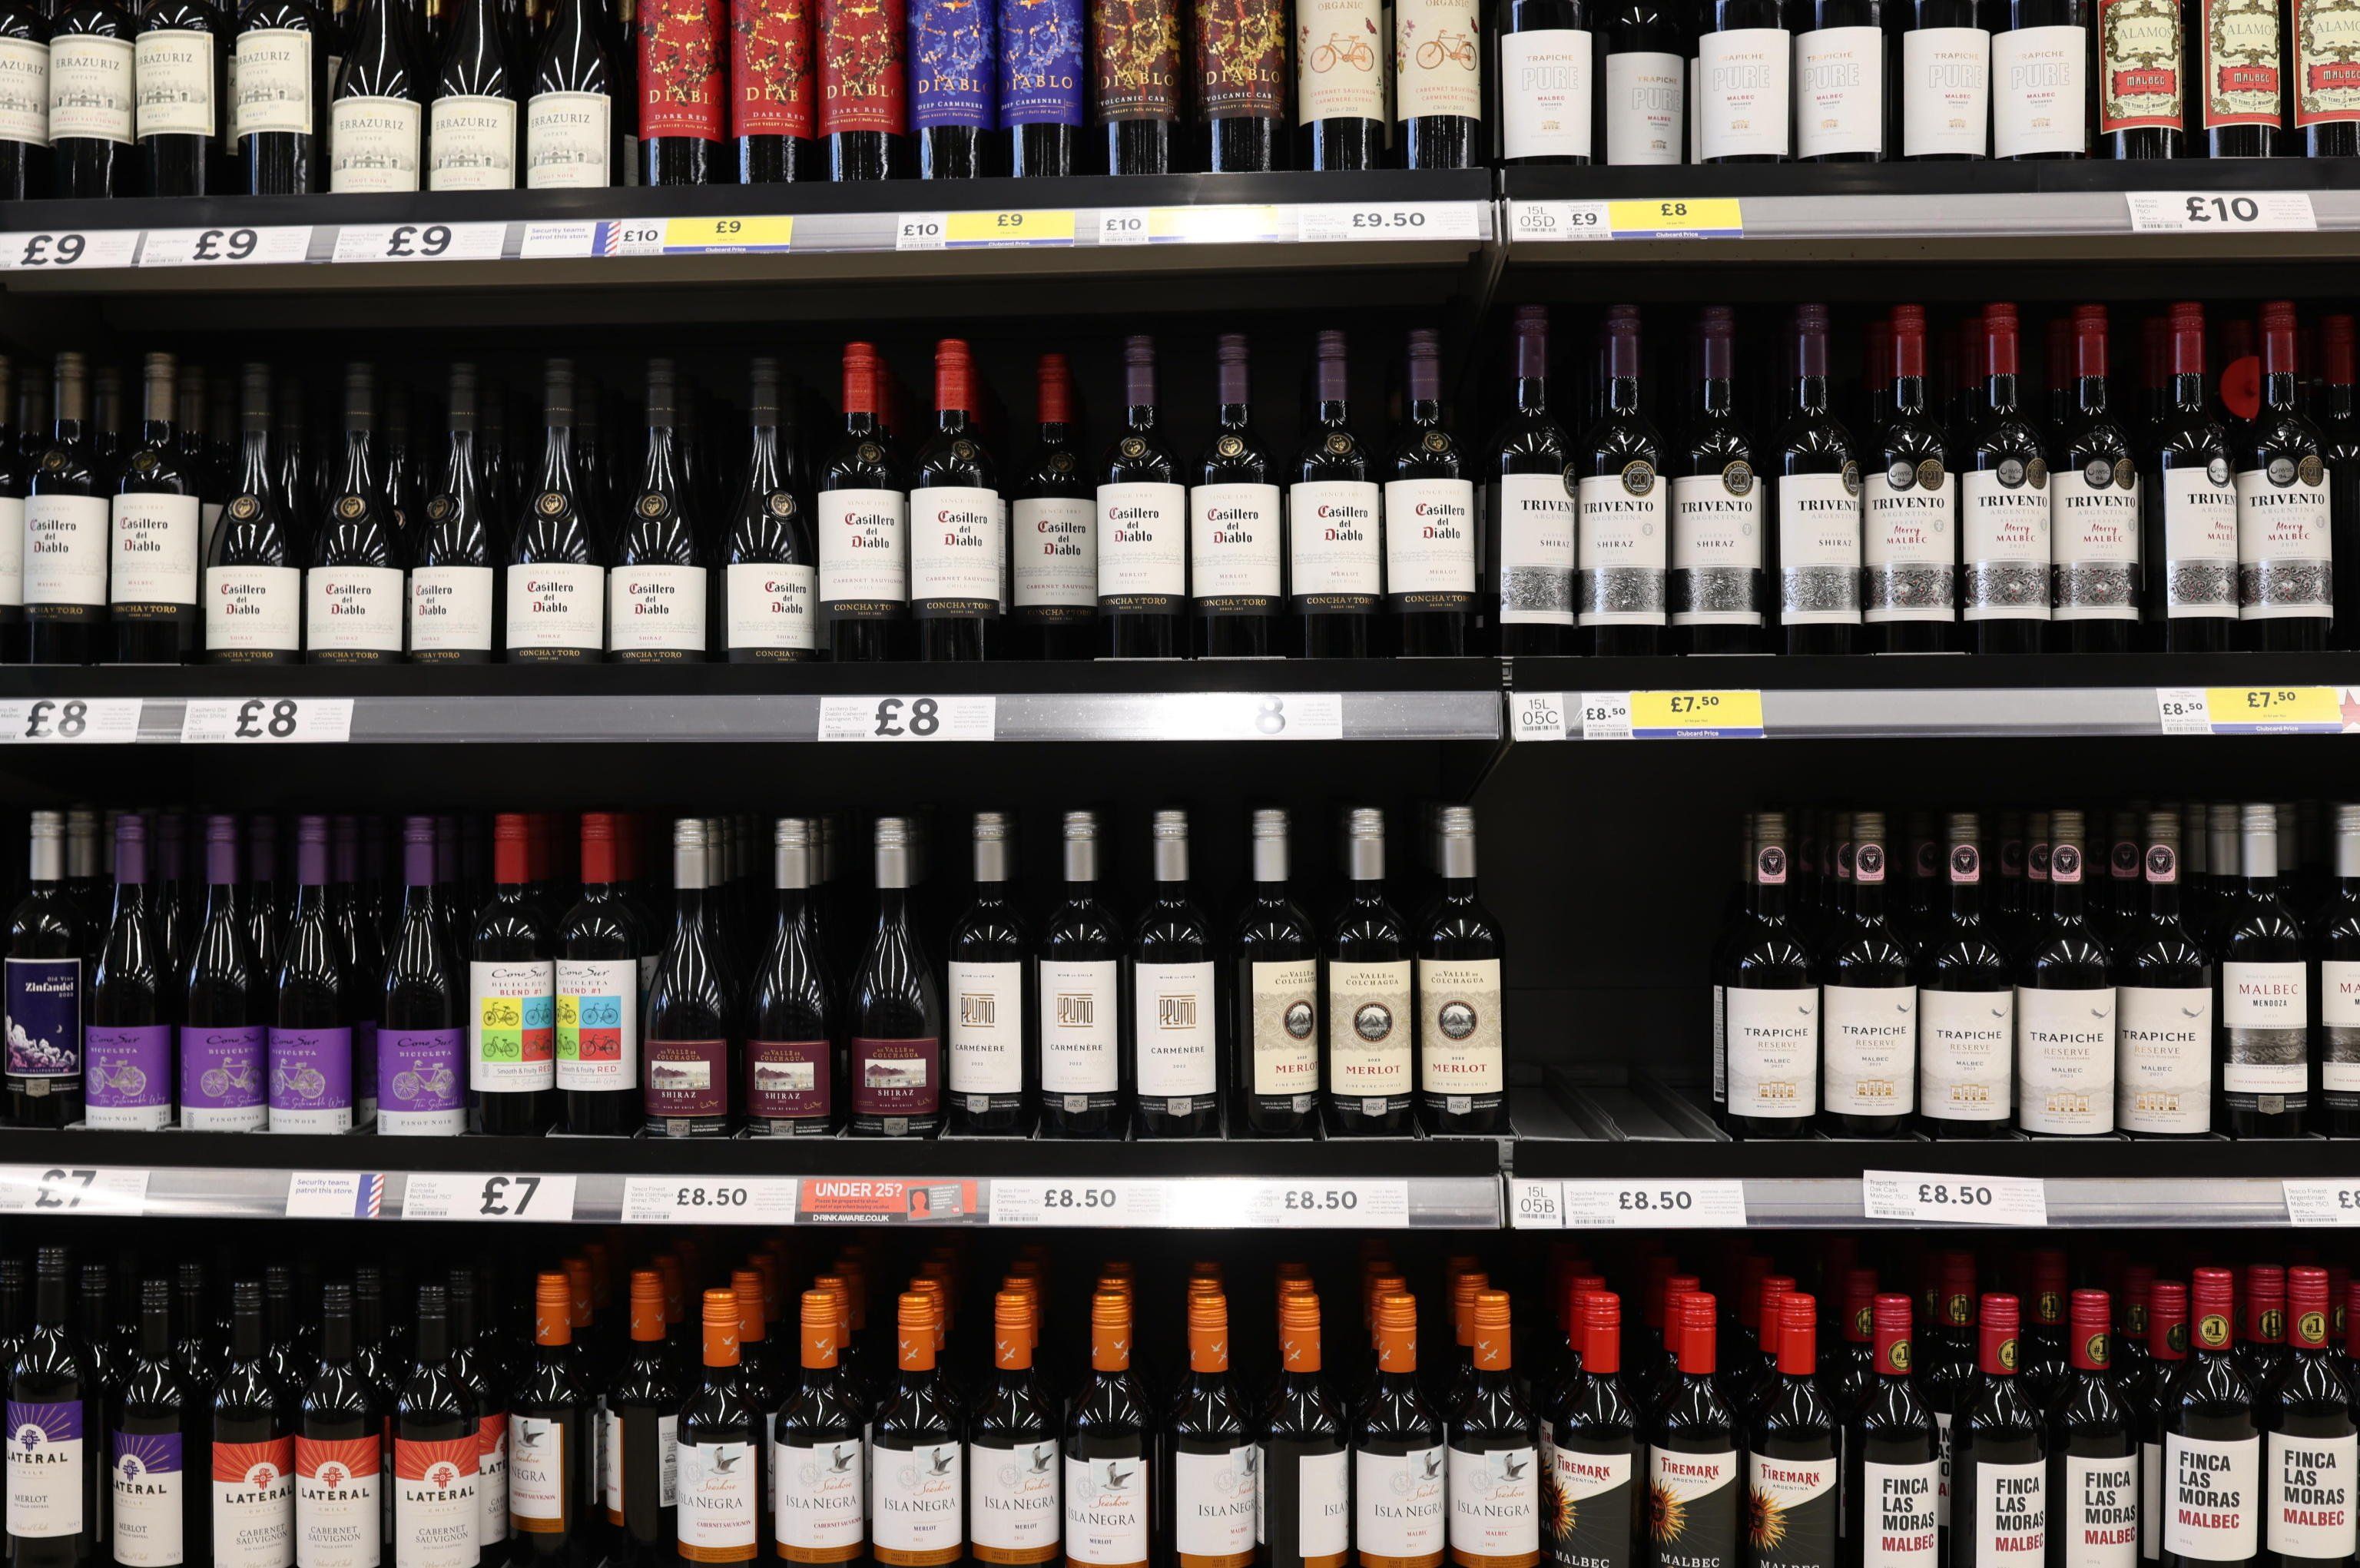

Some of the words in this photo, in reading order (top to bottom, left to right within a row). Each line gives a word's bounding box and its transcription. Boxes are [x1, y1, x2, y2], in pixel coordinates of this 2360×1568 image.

[2120, 26, 2172, 39] ALAMOS
[56, 58, 120, 72] ERRAZURIZ
[1206, 69, 1280, 85] DIABLO
[1522, 67, 1579, 91] PURE
[1713, 65, 1770, 91] PURE
[1929, 65, 1982, 88] PURE
[2127, 75, 2165, 86] MALBEC
[1101, 95, 1143, 107] VOLCANIC
[340, 119, 404, 131] ERRAZURIZ
[436, 118, 498, 129] ERRAZURIZ
[1527, 206, 1547, 214] 15L
[1661, 204, 1687, 216] £8
[2186, 196, 2258, 221] £10
[997, 214, 1023, 227] £9
[1106, 219, 1142, 230] £10
[1352, 212, 1425, 227] £9.50
[1520, 217, 1555, 227] 05D
[1572, 214, 1597, 225] £9
[716, 221, 741, 234] £9
[903, 224, 939, 236] £10
[386, 226, 452, 257] £9
[624, 230, 658, 241] £10
[21, 234, 86, 266] £9
[193, 230, 257, 260] £9
[1415, 503, 1464, 517] Casillero
[1584, 501, 1653, 513] TRIVENTO
[1681, 501, 1752, 513] TRIVENTO
[1872, 497, 1944, 510] TRIVENTO
[938, 510, 987, 525] Casillero
[1437, 518, 1449, 526] del
[1423, 526, 1460, 539] Diablo
[1894, 525, 1921, 536] Merry
[2004, 522, 2030, 535] Merry
[944, 533, 982, 547] Diablo
[221, 584, 266, 595] Casillero
[528, 582, 573, 592] Casillero
[227, 604, 260, 615] Diablo
[533, 602, 568, 613] Diablo
[1529, 699, 1550, 710] 15L
[1671, 696, 1719, 713] £7.50
[2248, 691, 2295, 708] £7.50
[1586, 708, 1626, 721] £8.50
[2163, 702, 2203, 715] £8.50
[25, 700, 88, 738] £8
[234, 700, 298, 738] £8
[874, 698, 940, 737] £8
[1523, 711, 1558, 725] 05C
[492, 969, 525, 978] Cono
[525, 967, 547, 980] Sur
[559, 966, 582, 976] Cono
[582, 966, 610, 978] Sur
[25, 983, 74, 992] Zinfandel
[2239, 983, 2299, 994] MALBEC
[1745, 1027, 1808, 1037] TRAPICHE
[1937, 1029, 2002, 1039] TRAPICHE
[2030, 1032, 2104, 1043] TRAPICHE
[1346, 1065, 1400, 1075] MERLOT
[1433, 1063, 1487, 1073] MERLOT
[35, 1169, 97, 1208] £7
[816, 1183, 871, 1198] UNDER
[875, 1183, 902, 1198] 25?
[1527, 1186, 1547, 1197] 15L
[1918, 1184, 1992, 1205] £8.50
[480, 1177, 540, 1215] £7
[677, 1188, 747, 1206] £8.50
[1045, 1189, 1116, 1208] £8.50
[1285, 1191, 1357, 1209] £8.50
[1619, 1192, 1692, 1209] £8.50
[1520, 1199, 1554, 1213] 05B
[2206, 1321, 2222, 1338] #1
[2305, 1317, 2322, 1334] #1
[2179, 1450, 2231, 1471] FINCA
[2285, 1450, 2335, 1469] FINCA
[1557, 1454, 1610, 1480] FIREMARK
[1661, 1457, 1719, 1480] FIREMARK
[1761, 1464, 1819, 1486] FIREMARK
[2179, 1469, 2210, 1488] LAS
[2284, 1468, 2316, 1487] LAS
[1883, 1477, 1928, 1494] FINCA
[15, 1495, 48, 1503] MERLOT
[227, 1484, 292, 1503] LATERAL
[302, 1487, 370, 1500] LATERAL
[406, 1486, 474, 1501] LATERAL
[2179, 1487, 2239, 1508] MORAS
[2284, 1487, 2345, 1505] MORAS
[786, 1494, 809, 1508] ISLA
[814, 1494, 857, 1510] NEGRA
[884, 1497, 909, 1511] ISLA
[913, 1497, 956, 1512] NEGRA
[1882, 1497, 1913, 1513] LAS
[1882, 1511, 1934, 1530] MORAS
[2179, 1508, 2239, 1529] MALBEC
[2284, 1508, 2345, 1527] MALBEC
[311, 1525, 357, 1534] CABERNET
[416, 1530, 469, 1543] SAUVIGNON
[419, 1524, 466, 1536] CABERNET
[309, 1533, 361, 1542] SAUVIGNON
[1882, 1533, 1934, 1552] MALBEC
[1556, 1550, 1609, 1568] MALBEC
